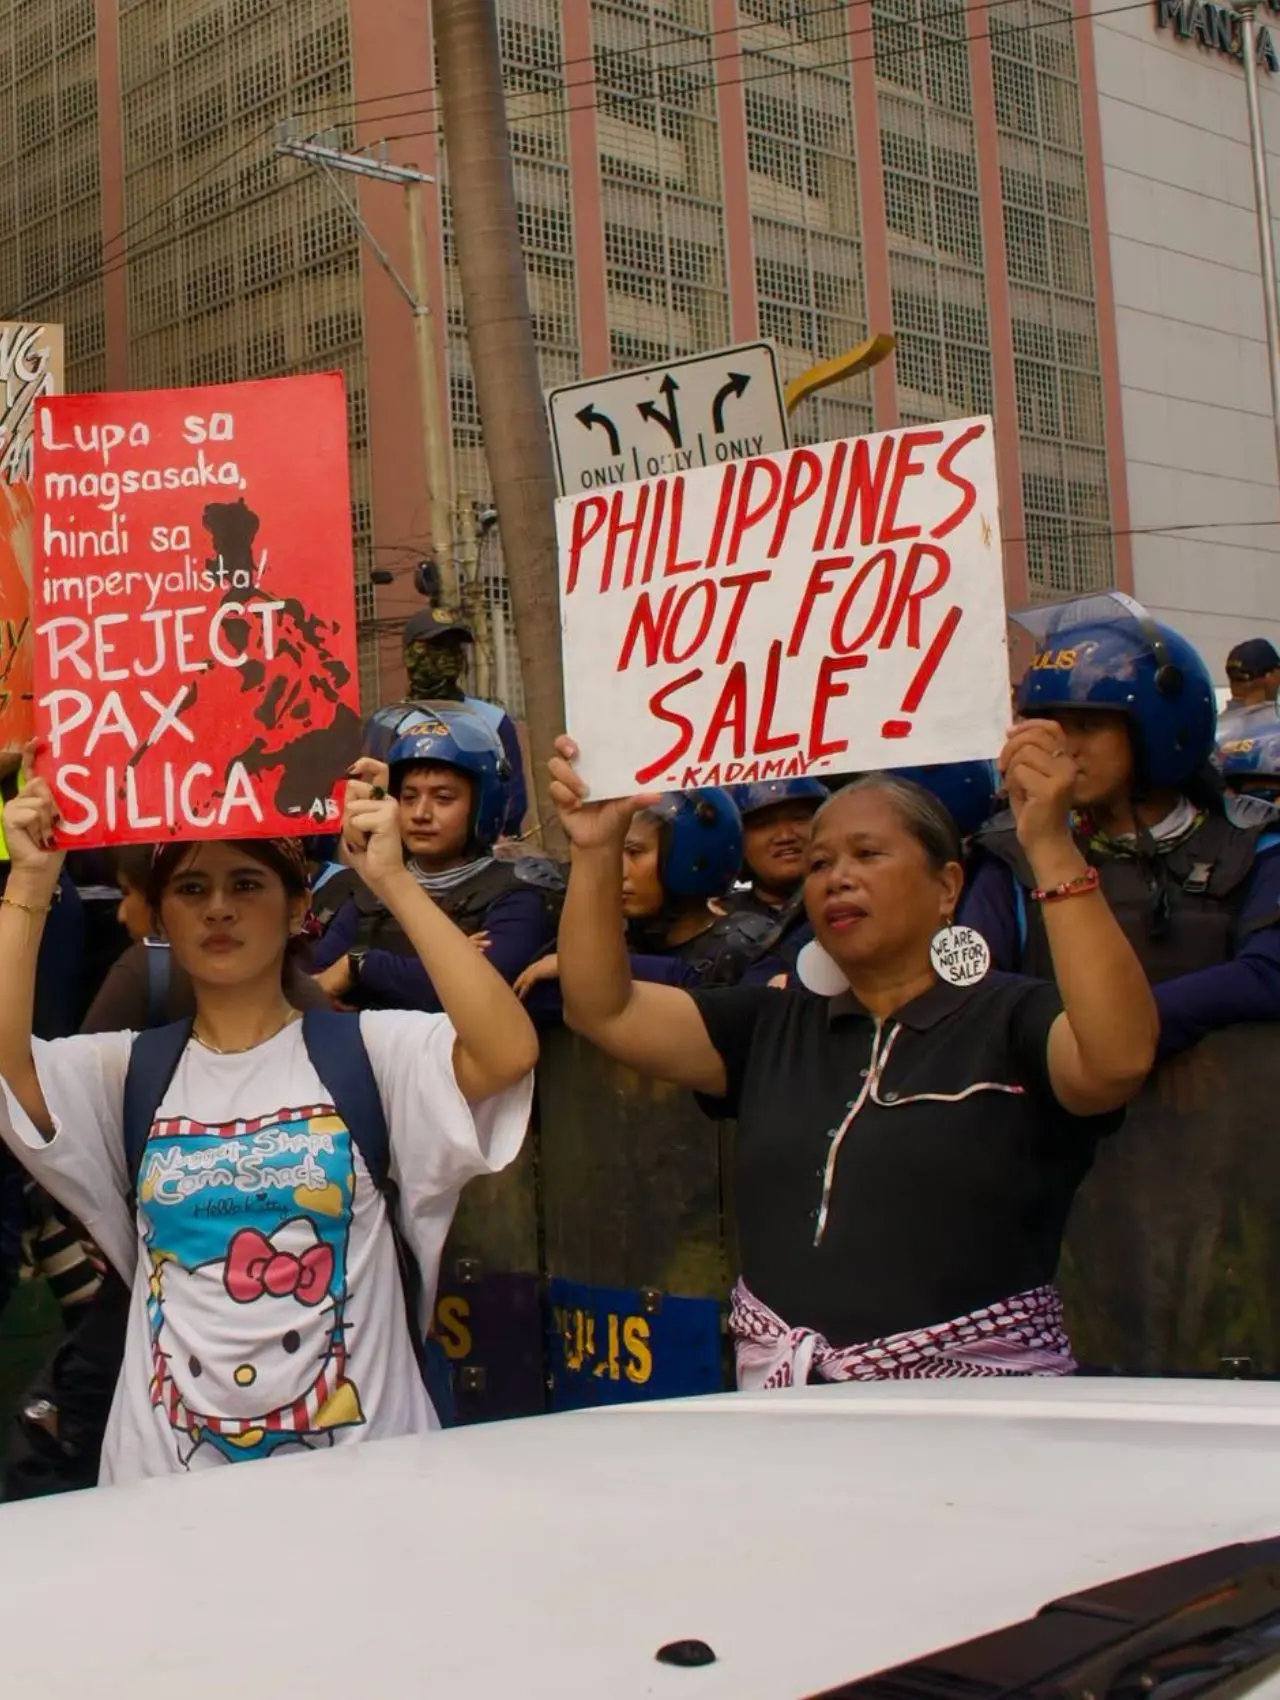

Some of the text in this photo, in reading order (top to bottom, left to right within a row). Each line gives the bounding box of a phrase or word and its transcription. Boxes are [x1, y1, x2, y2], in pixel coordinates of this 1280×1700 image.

[40, 407, 235, 465] Lupa sa
[715, 435, 764, 462] ONLY
[44, 450, 247, 511] magsasaka,
[581, 463, 626, 489] ONLY
[43, 513, 191, 558] hindi sa
[566, 424, 986, 595] PHILIPPINES
[43, 548, 268, 610] imperyalista!
[617, 543, 951, 672] NOT FOR
[36, 601, 286, 682] REJECT
[38, 685, 195, 758] PAX
[56, 761, 264, 836] SILICA
[932, 930, 974, 956] WE ARE
[940, 944, 983, 968] NOT FOR
[153, 1167, 234, 1205] Corn
